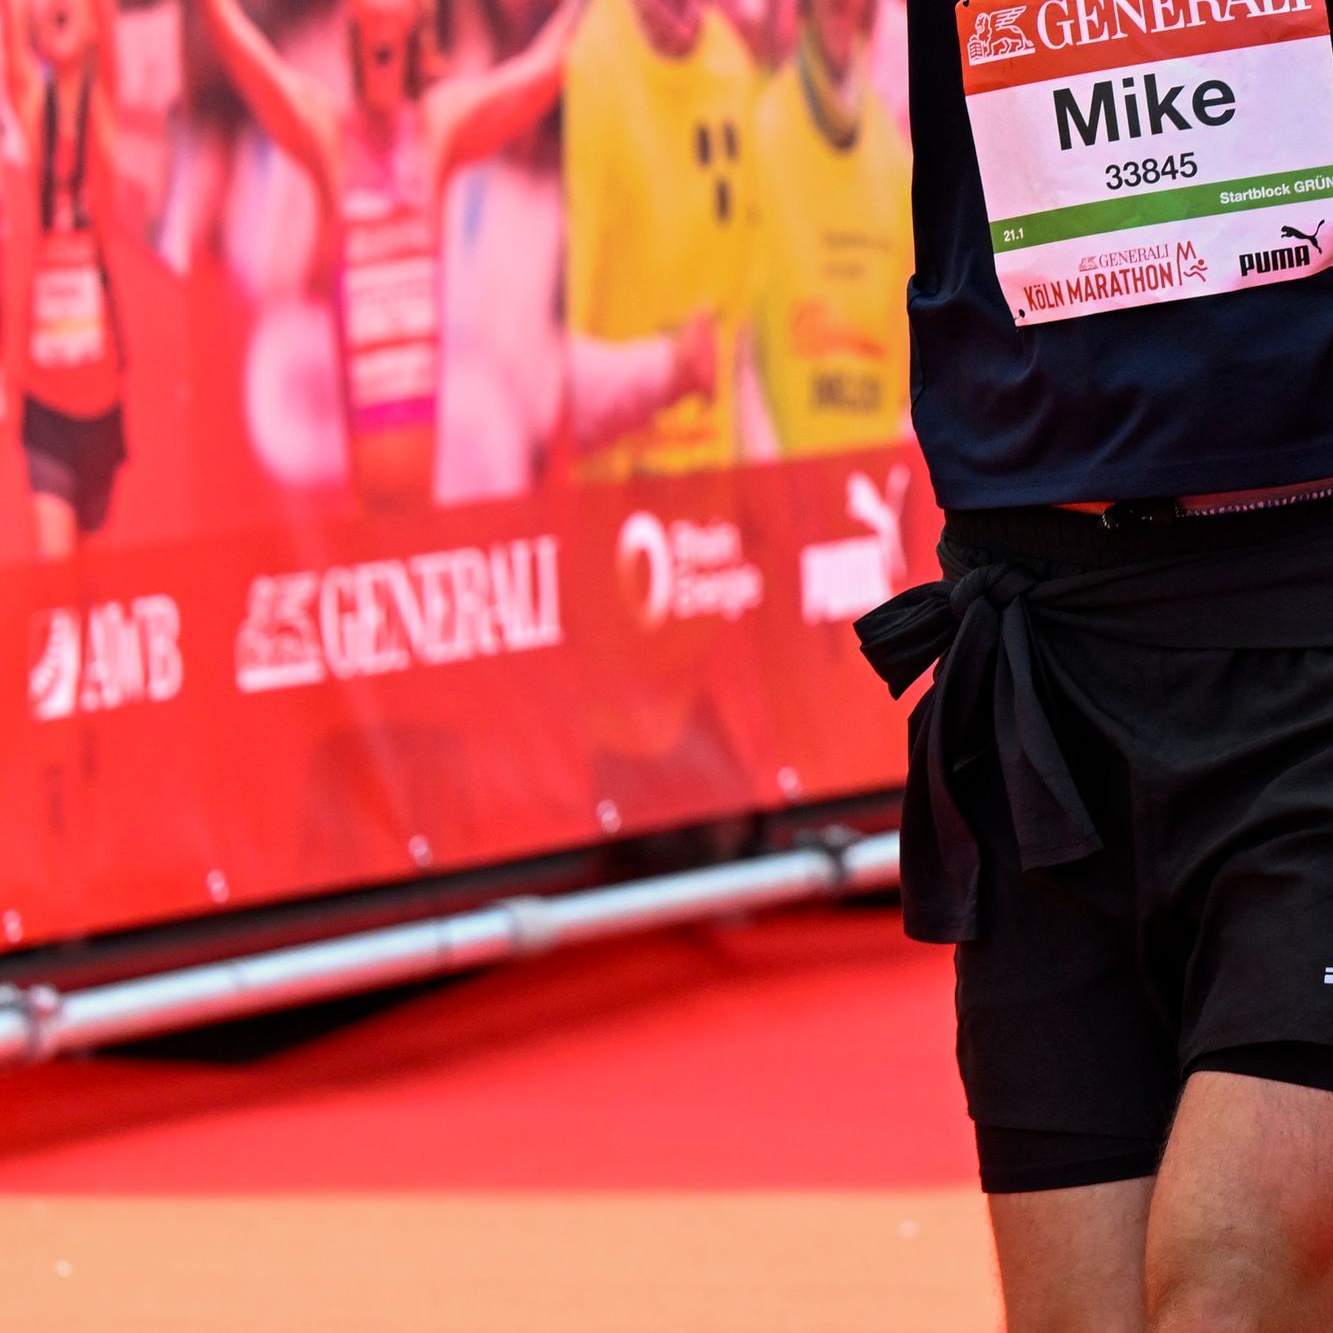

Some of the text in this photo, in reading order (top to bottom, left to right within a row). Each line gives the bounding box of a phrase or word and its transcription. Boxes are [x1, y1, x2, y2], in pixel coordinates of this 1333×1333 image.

[1053, 74, 1236, 150] Mike
[1105, 152, 1198, 190] 33845
[1219, 182, 1291, 205] Startblock
[1003, 227, 1024, 243] 21.1
[1099, 244, 1169, 268] GENERALI
[1239, 244, 1311, 277] PUMA
[1023, 261, 1174, 312] KÖLN MARATHON
[320, 535, 563, 678] GENERALI
